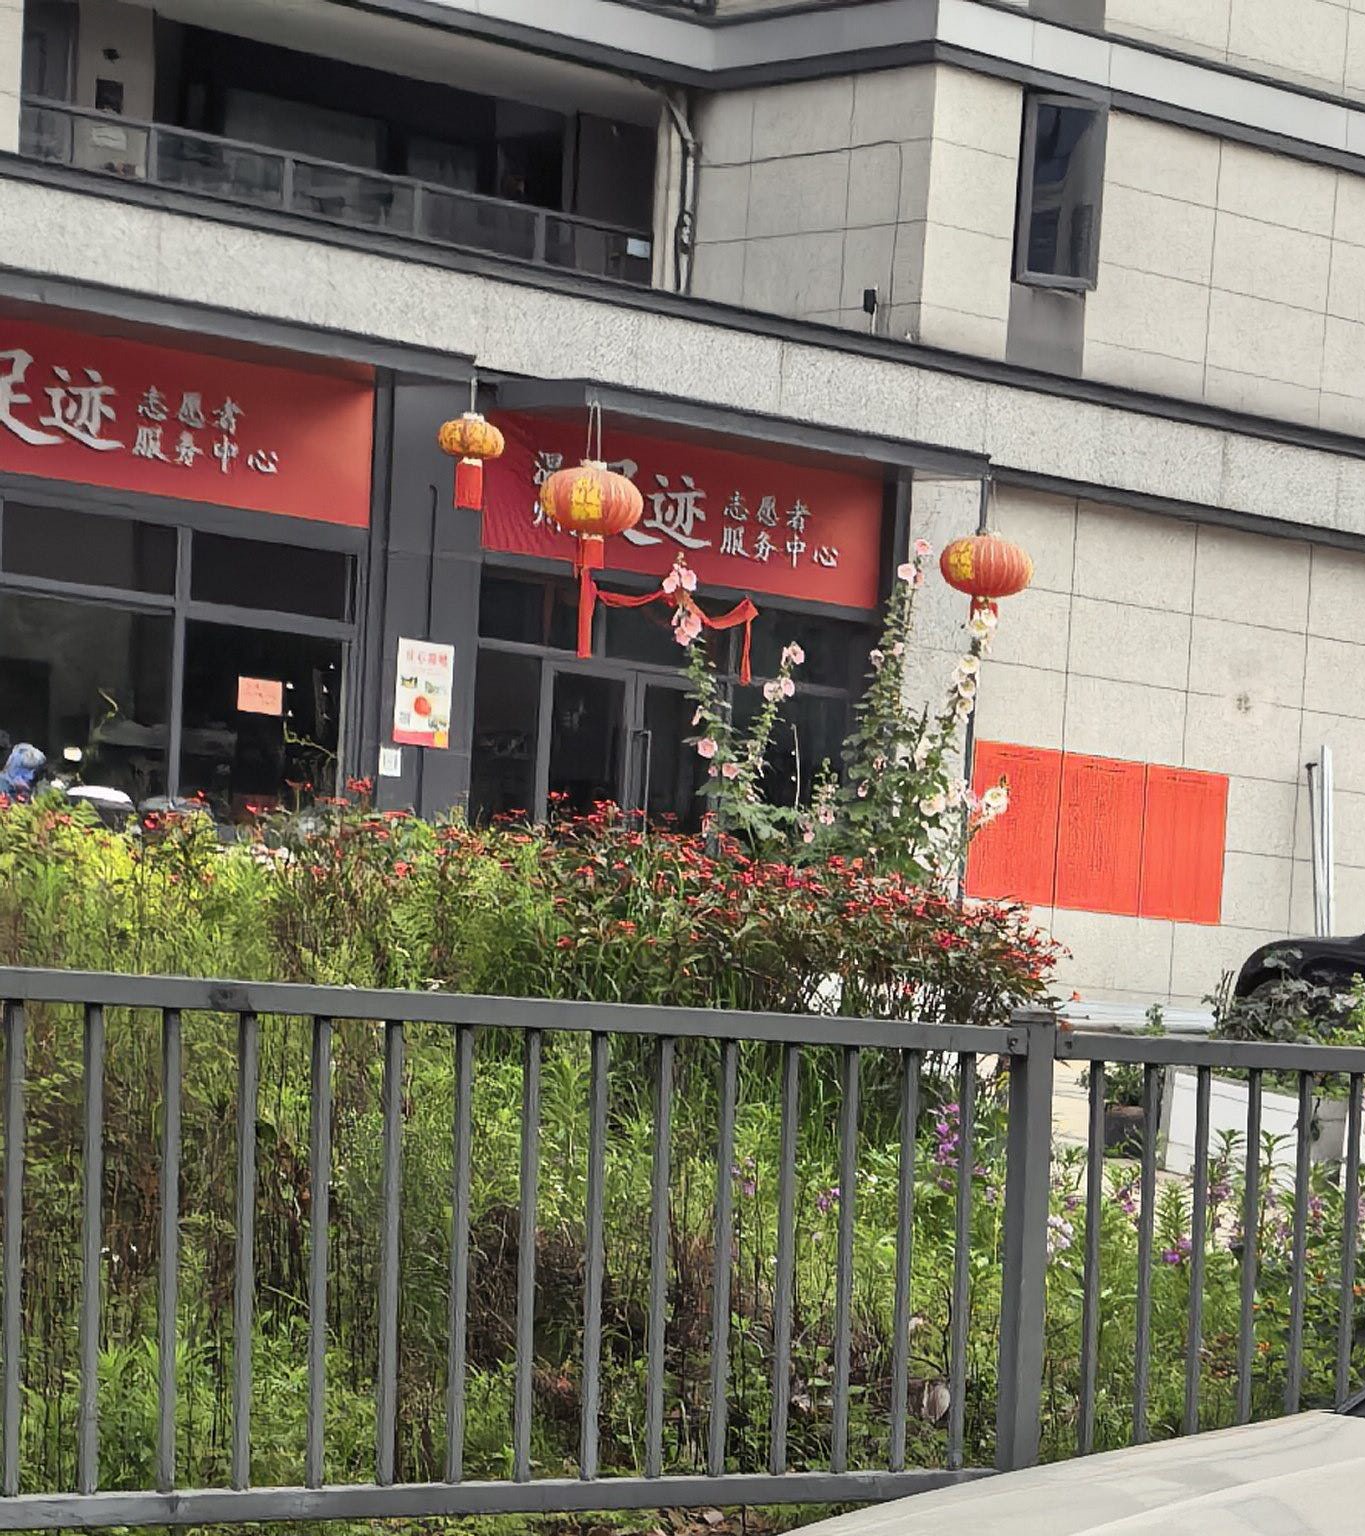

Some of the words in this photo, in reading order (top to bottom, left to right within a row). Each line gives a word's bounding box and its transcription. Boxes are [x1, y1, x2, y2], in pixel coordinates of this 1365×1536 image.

[132, 425, 279, 474] 服务中心
[724, 490, 811, 533] 志愿者
[720, 527, 838, 568] 服务中心
